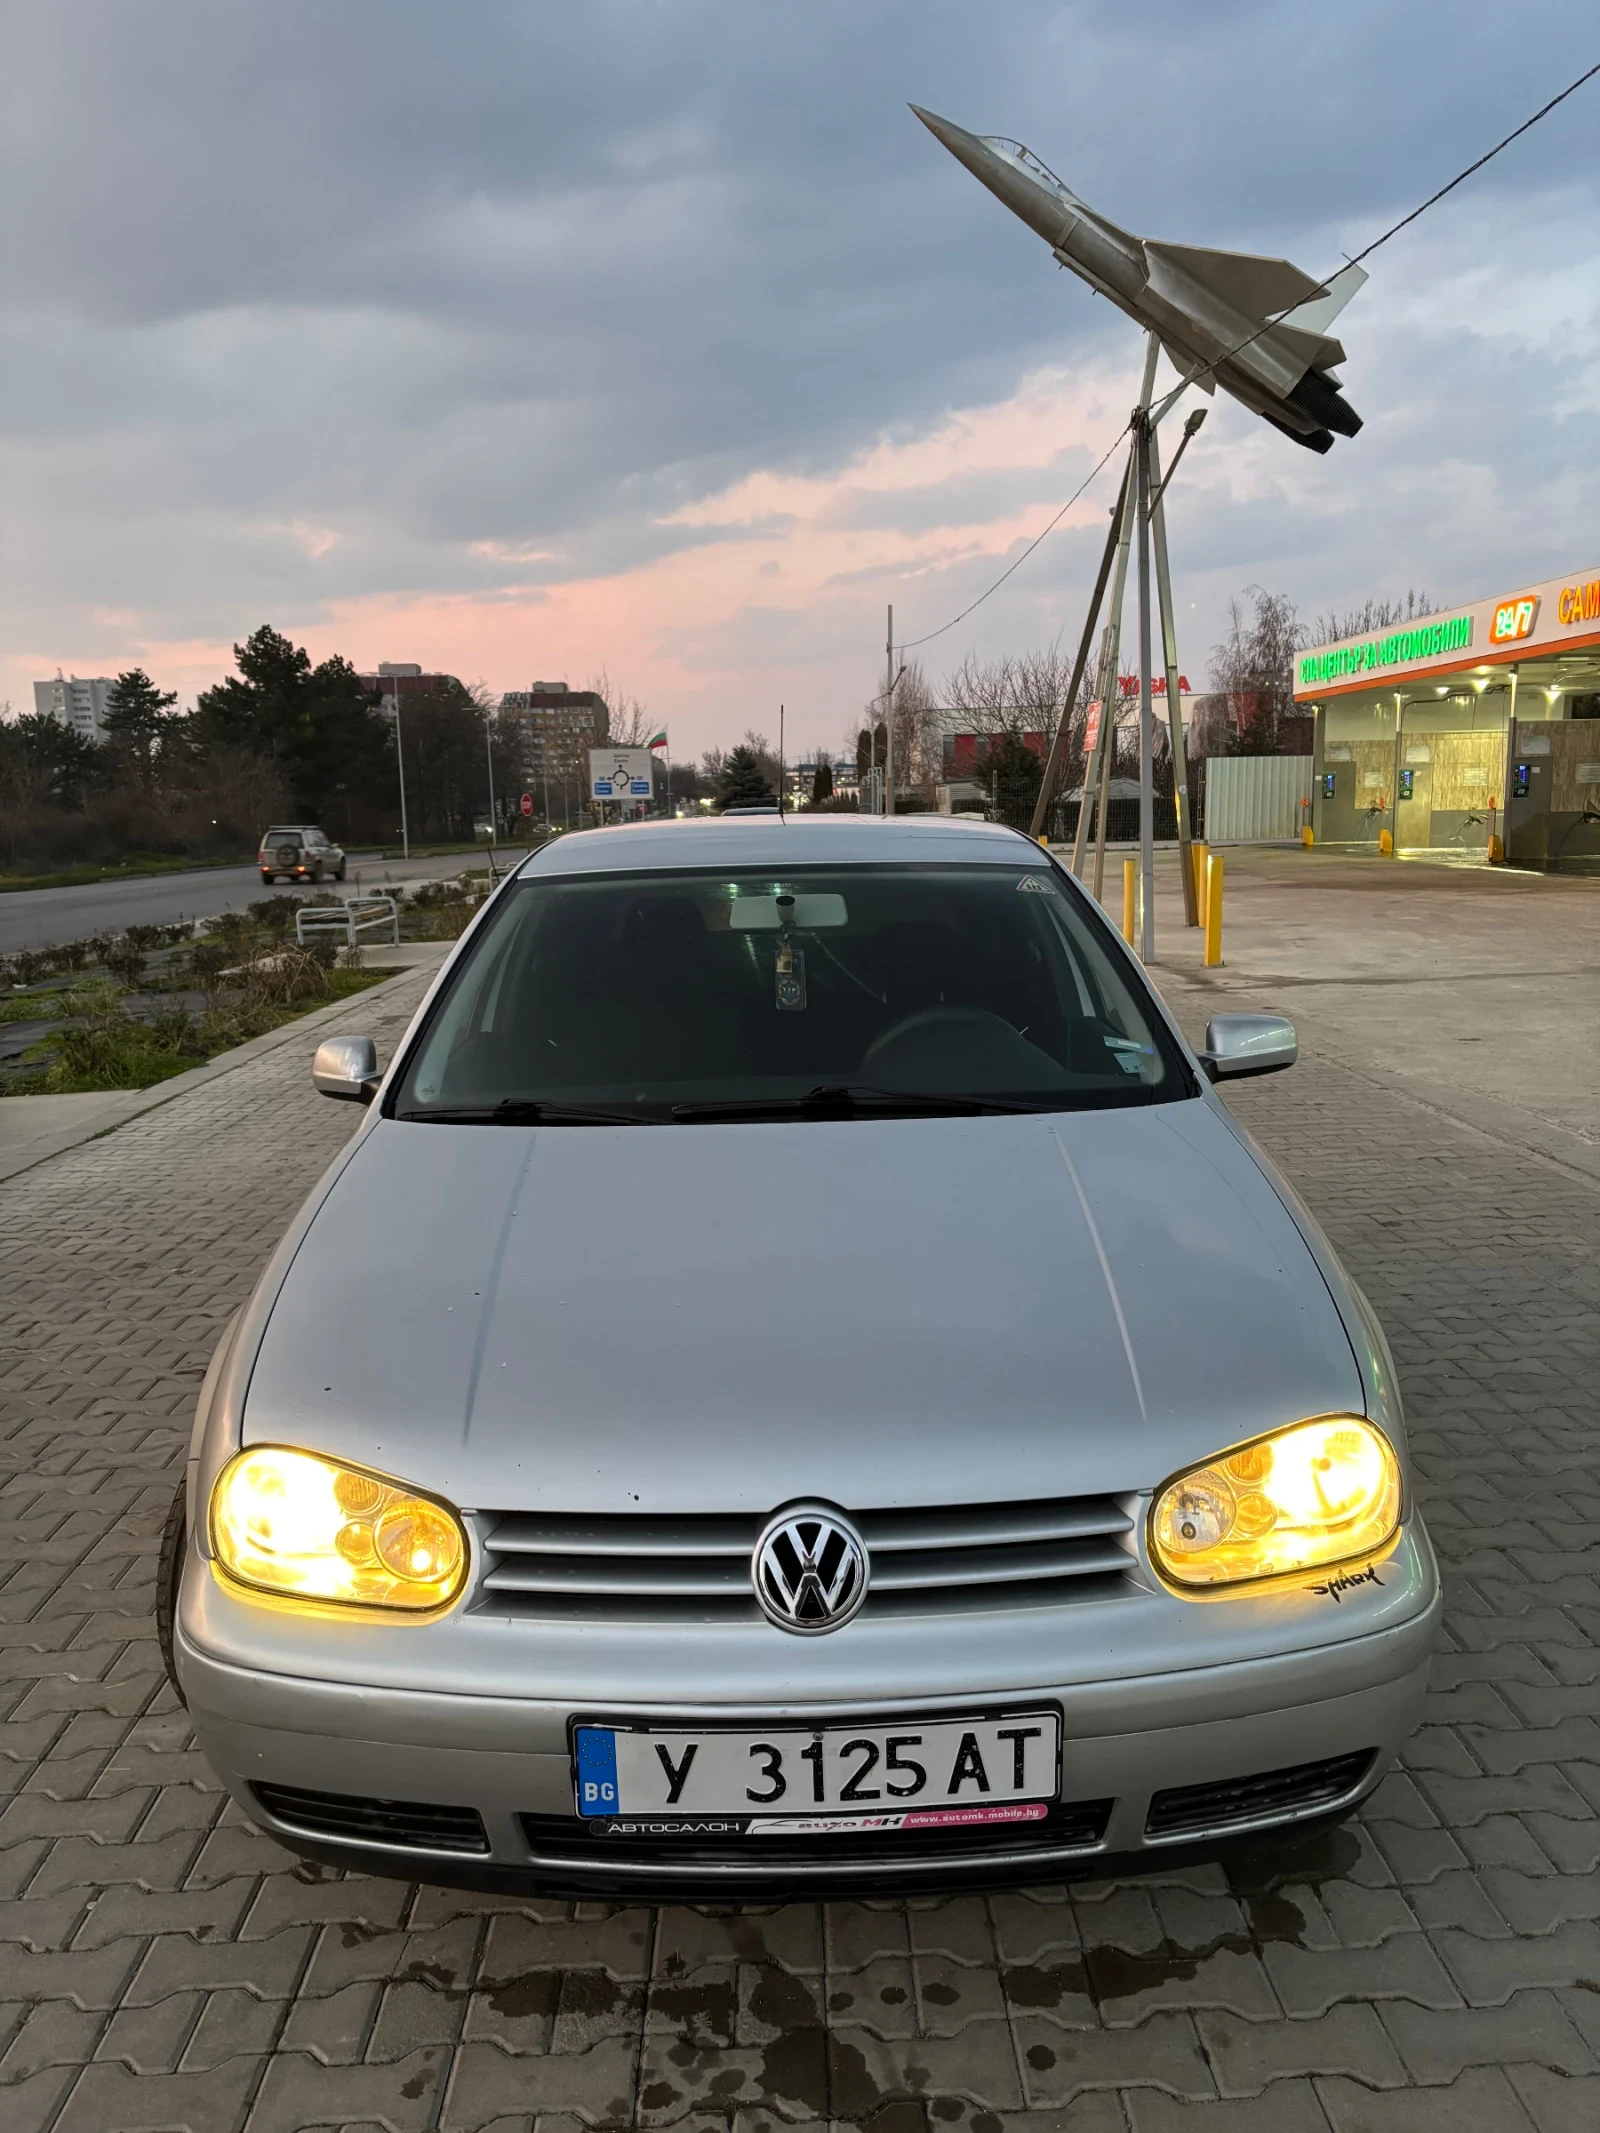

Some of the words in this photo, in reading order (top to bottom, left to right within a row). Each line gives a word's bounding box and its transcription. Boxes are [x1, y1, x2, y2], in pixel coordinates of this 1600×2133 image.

[1495, 601, 1533, 638] 24/7
[1299, 655, 1320, 685] СПА
[1320, 645, 1361, 683] ЦЕНТЪР
[1361, 641, 1378, 670] ЗА
[1379, 615, 1470, 666] АВТОМОБИЛИ
[1301, 1562, 1386, 1603] SHARK
[746, 1736, 927, 1804] 3125
[584, 1782, 615, 1802] BG
[608, 1822, 740, 1834] АВТОСАЛОН
[909, 1807, 1039, 1825] www.automk.mobile.bg
